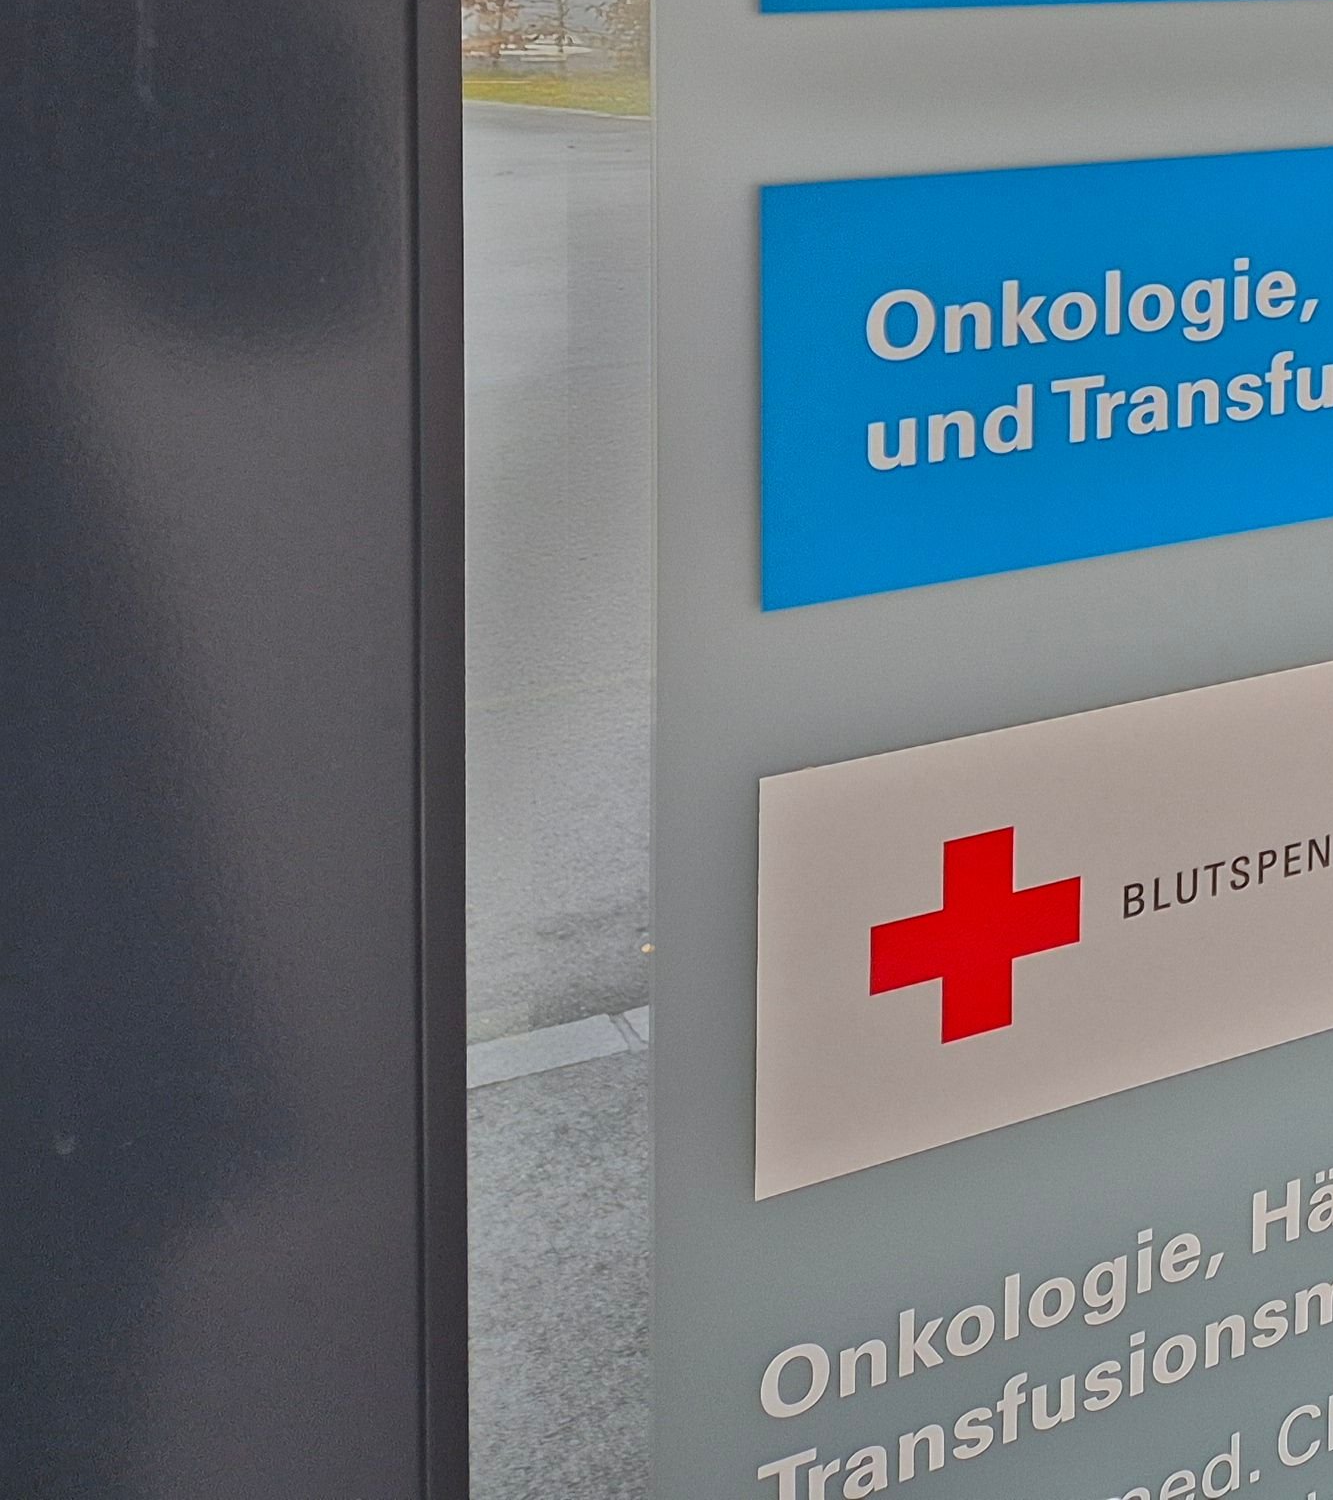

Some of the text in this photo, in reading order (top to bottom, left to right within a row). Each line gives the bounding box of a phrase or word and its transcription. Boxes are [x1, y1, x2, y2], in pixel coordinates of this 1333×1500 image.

[865, 257, 1317, 362] Onkologie,
[865, 383, 1035, 471] und
[759, 1228, 1225, 1420] Onkologie,
